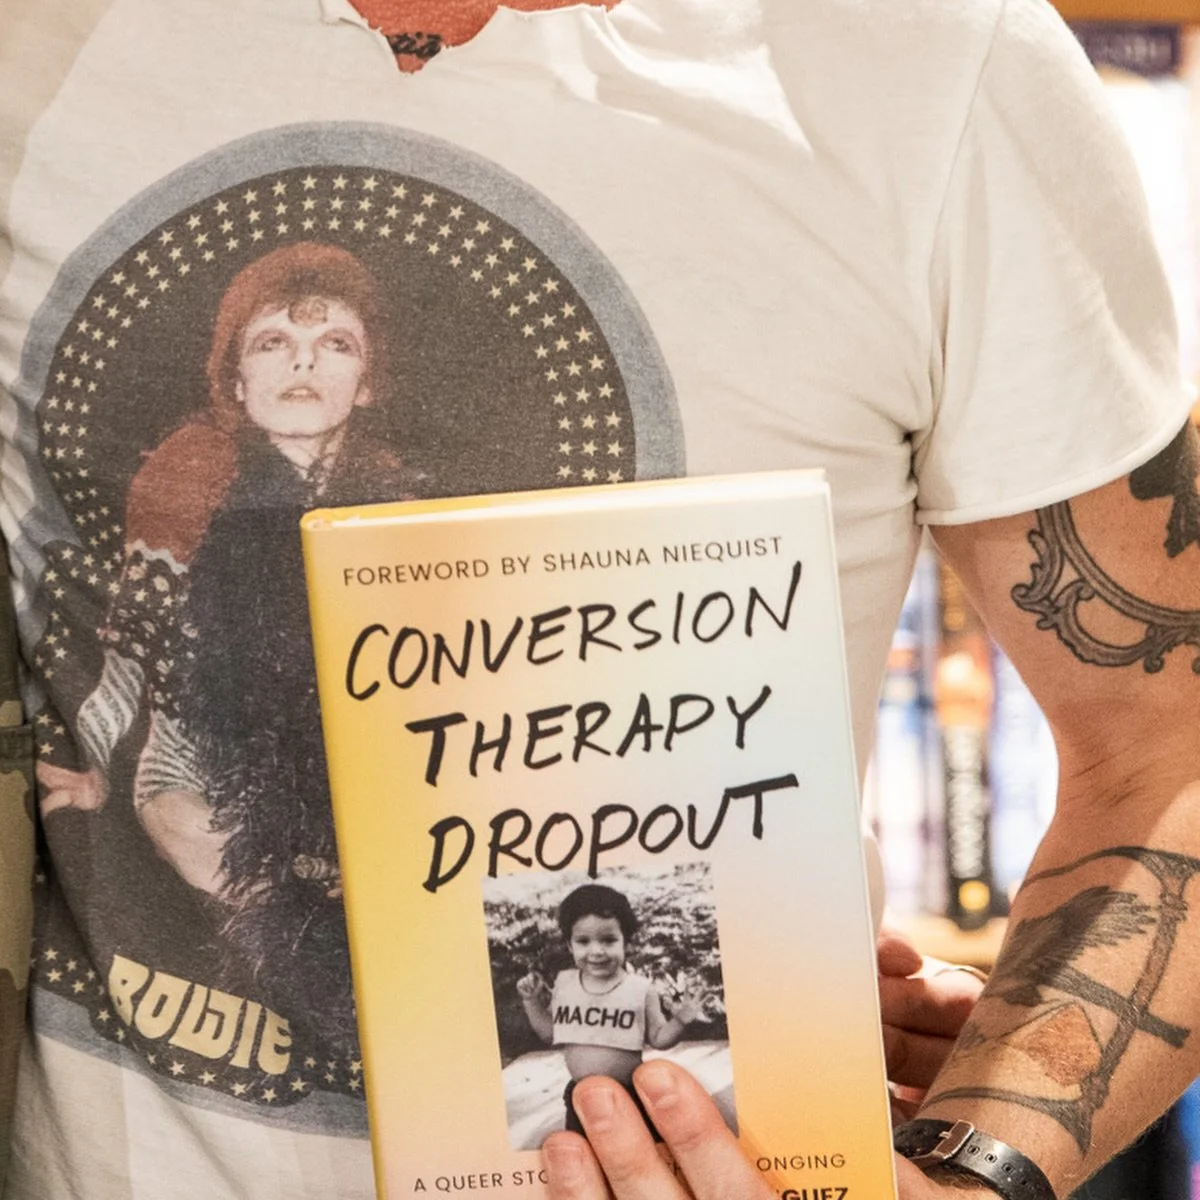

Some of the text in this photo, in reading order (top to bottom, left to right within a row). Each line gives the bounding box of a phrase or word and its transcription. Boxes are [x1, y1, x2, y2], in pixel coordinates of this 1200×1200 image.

[343, 536, 783, 587] FOREWORD BY SHAUNA NIEQUIST
[345, 560, 802, 701] CONVERSION
[406, 685, 771, 787] THERAPY
[422, 773, 799, 892] DROPOUT
[108, 954, 293, 1076] BOWIE
[553, 1003, 636, 1031] MACHO
[414, 1153, 846, 1193] A QUEER STO ONGING
